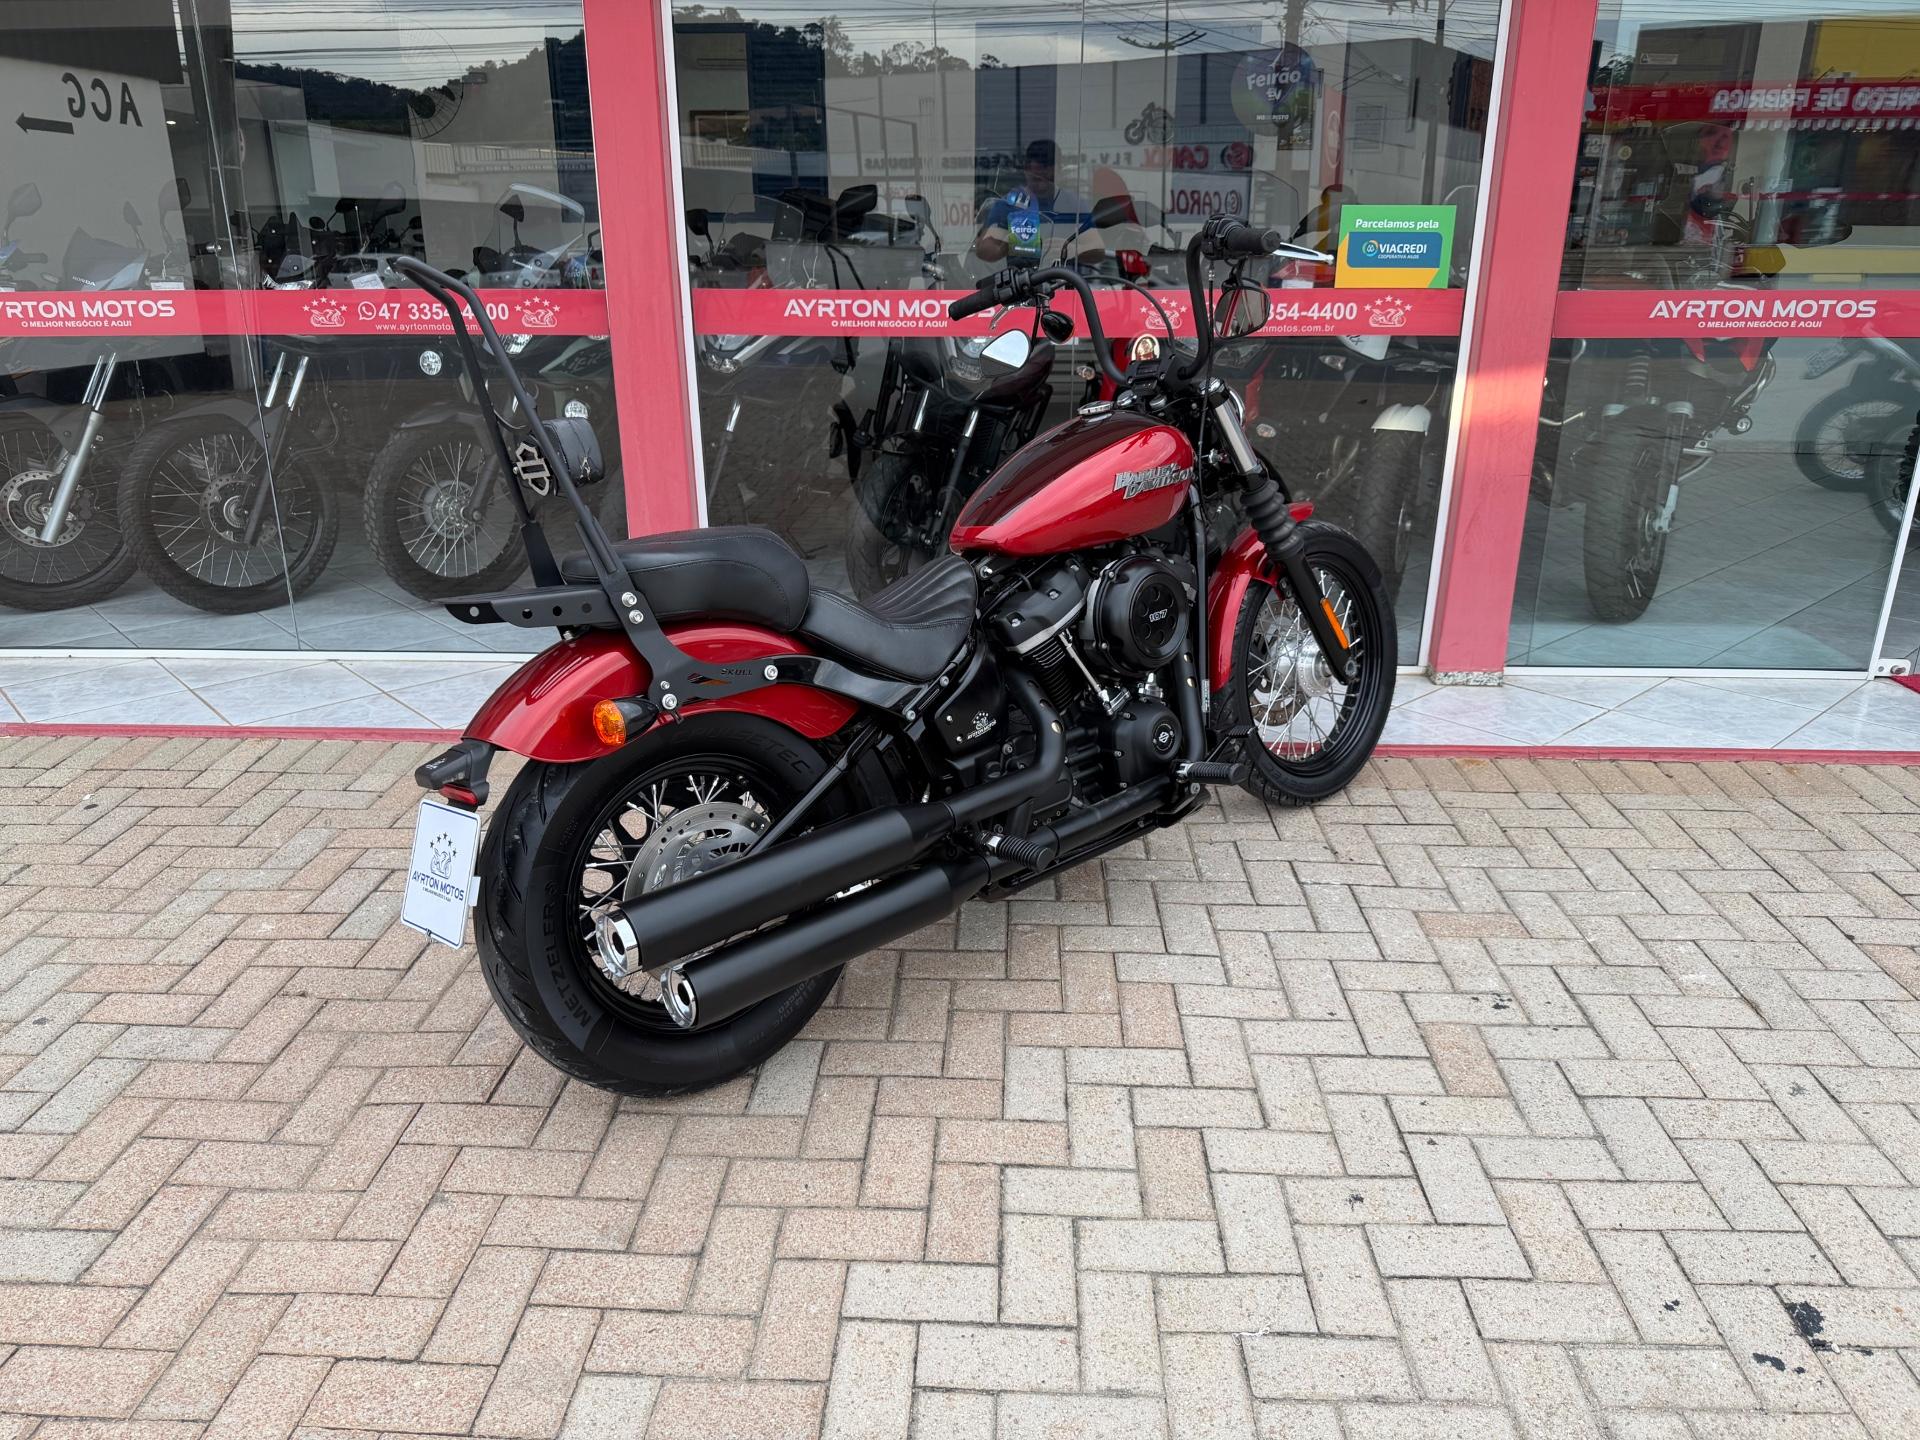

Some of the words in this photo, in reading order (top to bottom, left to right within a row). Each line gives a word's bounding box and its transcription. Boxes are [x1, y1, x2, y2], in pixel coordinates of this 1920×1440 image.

[1246, 67, 1301, 90] Feirão
[1011, 225, 1037, 234] Feirão
[1355, 218, 1415, 229] Parcelamos
[1416, 219, 1439, 230] pela
[1379, 243, 1427, 254] VIACREDI
[0, 300, 76, 319] RTON
[81, 299, 176, 319] MOTOS
[378, 303, 401, 321] 47
[784, 299, 891, 318] AYRTON
[1648, 299, 1765, 319] AYRTON
[1771, 299, 1878, 319] MOTOS
[21, 320, 29, 328] O
[29, 320, 64, 328] MELHOR
[65, 319, 103, 328] NEGÓCIO
[103, 319, 110, 328] É
[110, 320, 132, 328] AQUI
[831, 320, 839, 328] O
[839, 320, 876, 328] MELHOR
[876, 319, 916, 328] NEGÓCIO
[917, 319, 924, 328] É
[925, 320, 948, 328] AQUI
[1697, 320, 1706, 329] O
[1706, 321, 1745, 329] MELHOR
[1746, 320, 1789, 329] NEGÓCIO
[1790, 319, 1797, 329] É
[1797, 321, 1823, 329] AQUI
[720, 668, 753, 677] SKULL
[411, 870, 440, 892] AYRTON
[439, 883, 465, 902] MOTOS
